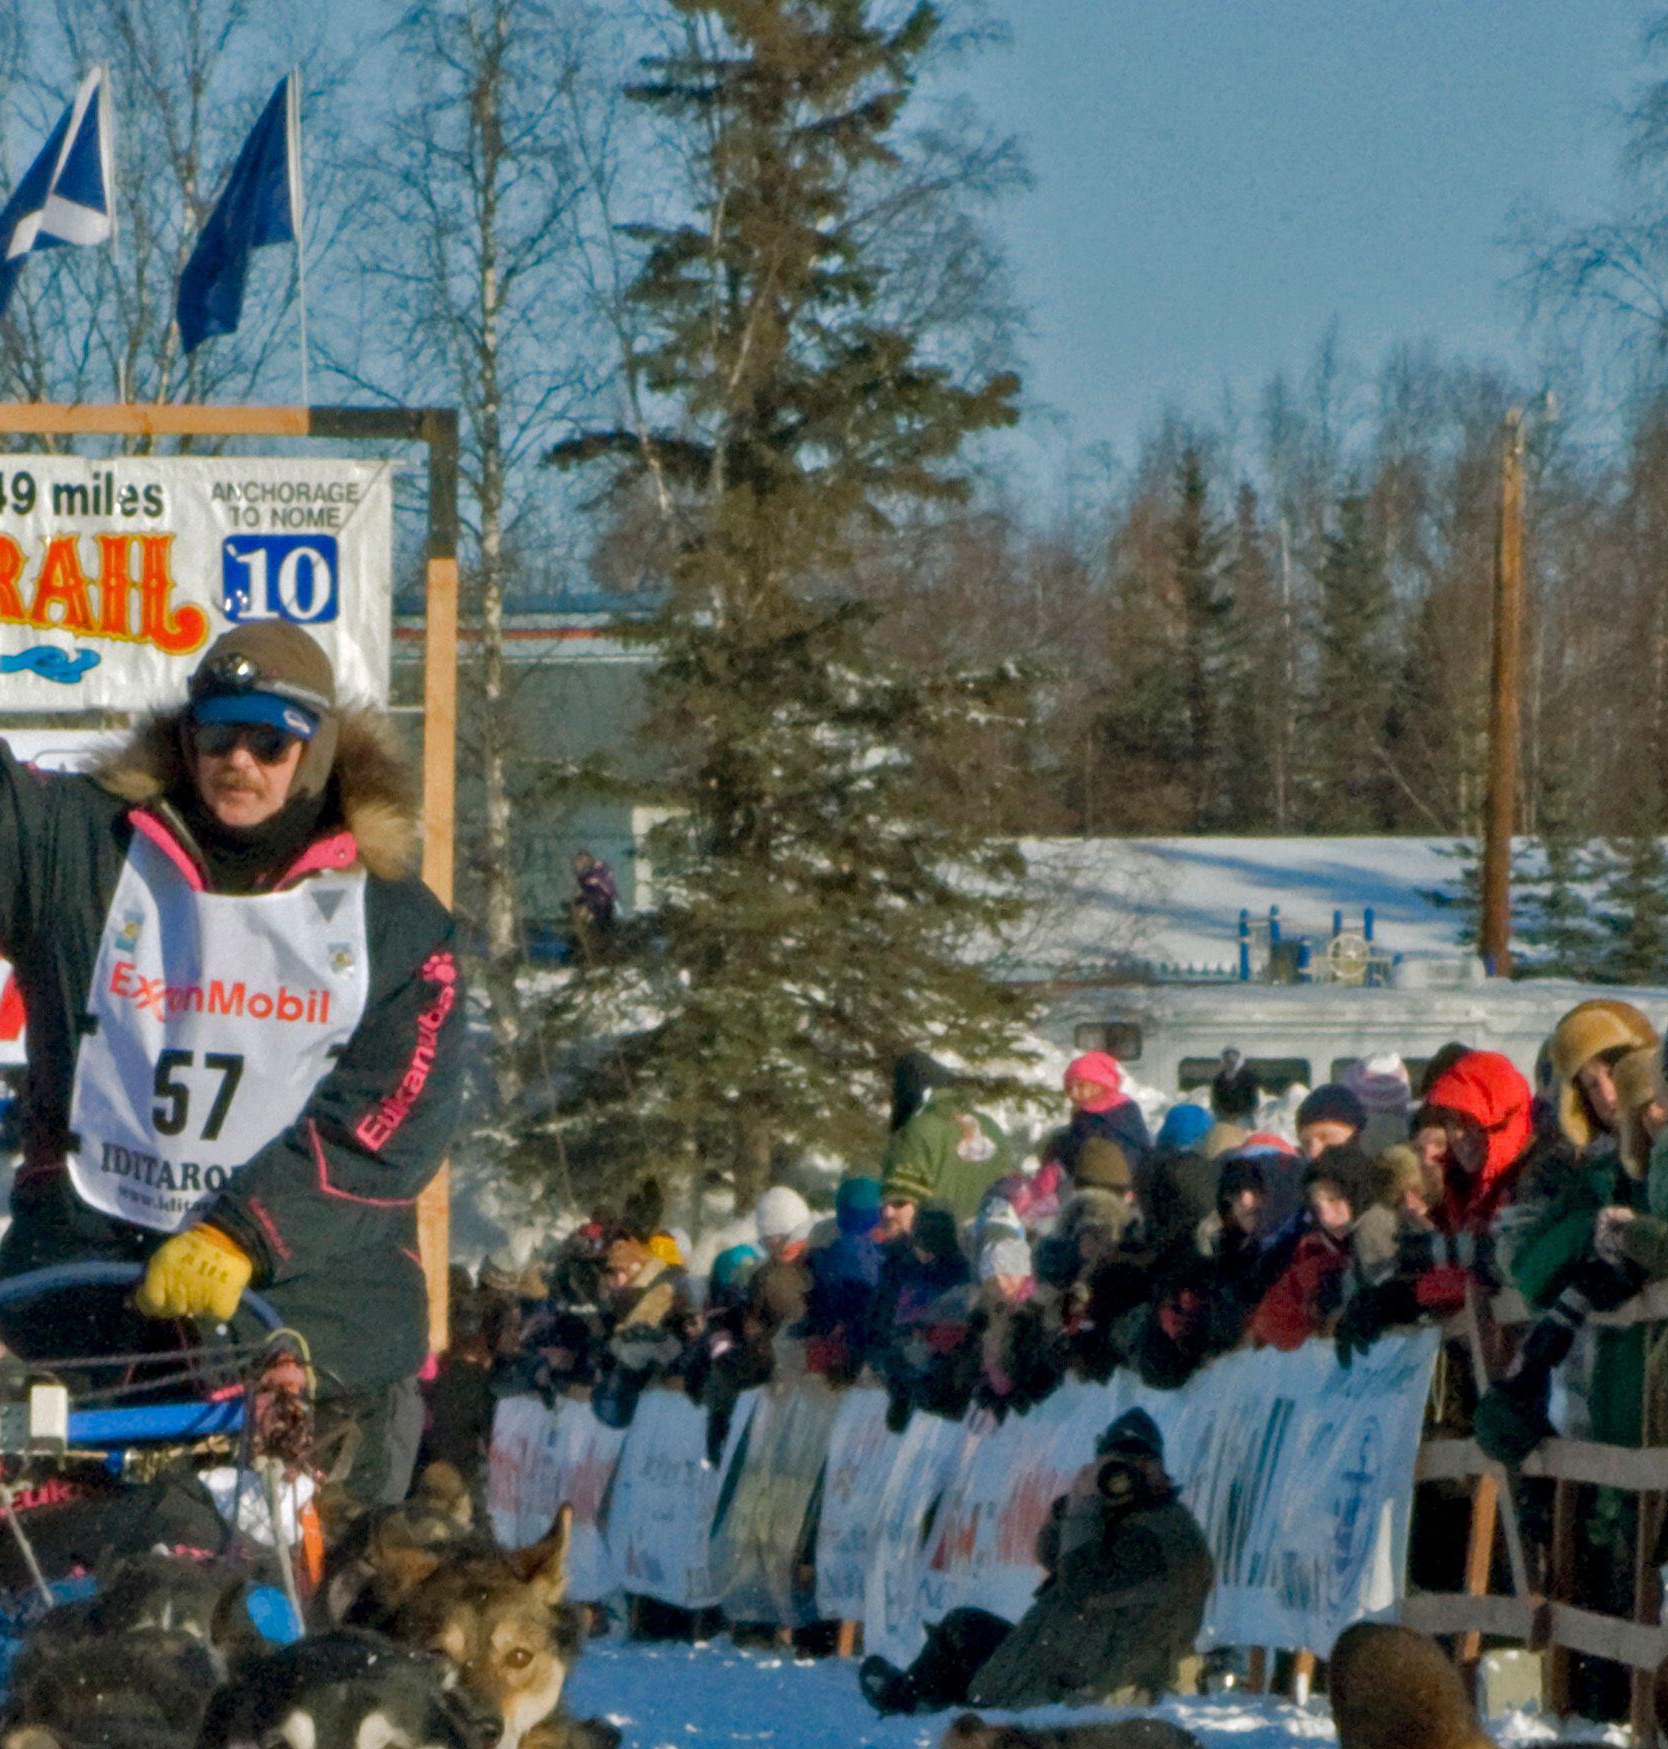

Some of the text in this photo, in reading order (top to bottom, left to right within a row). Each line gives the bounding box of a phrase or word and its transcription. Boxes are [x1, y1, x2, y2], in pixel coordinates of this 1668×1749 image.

[52, 471, 164, 518] miles
[212, 481, 359, 504] ANCHORAGE
[231, 506, 343, 528] TO NOME
[236, 546, 332, 620] 10
[109, 960, 331, 1025] ExxonMobil
[151, 1047, 244, 1141] 57
[101, 1142, 228, 1193] IDITARO
